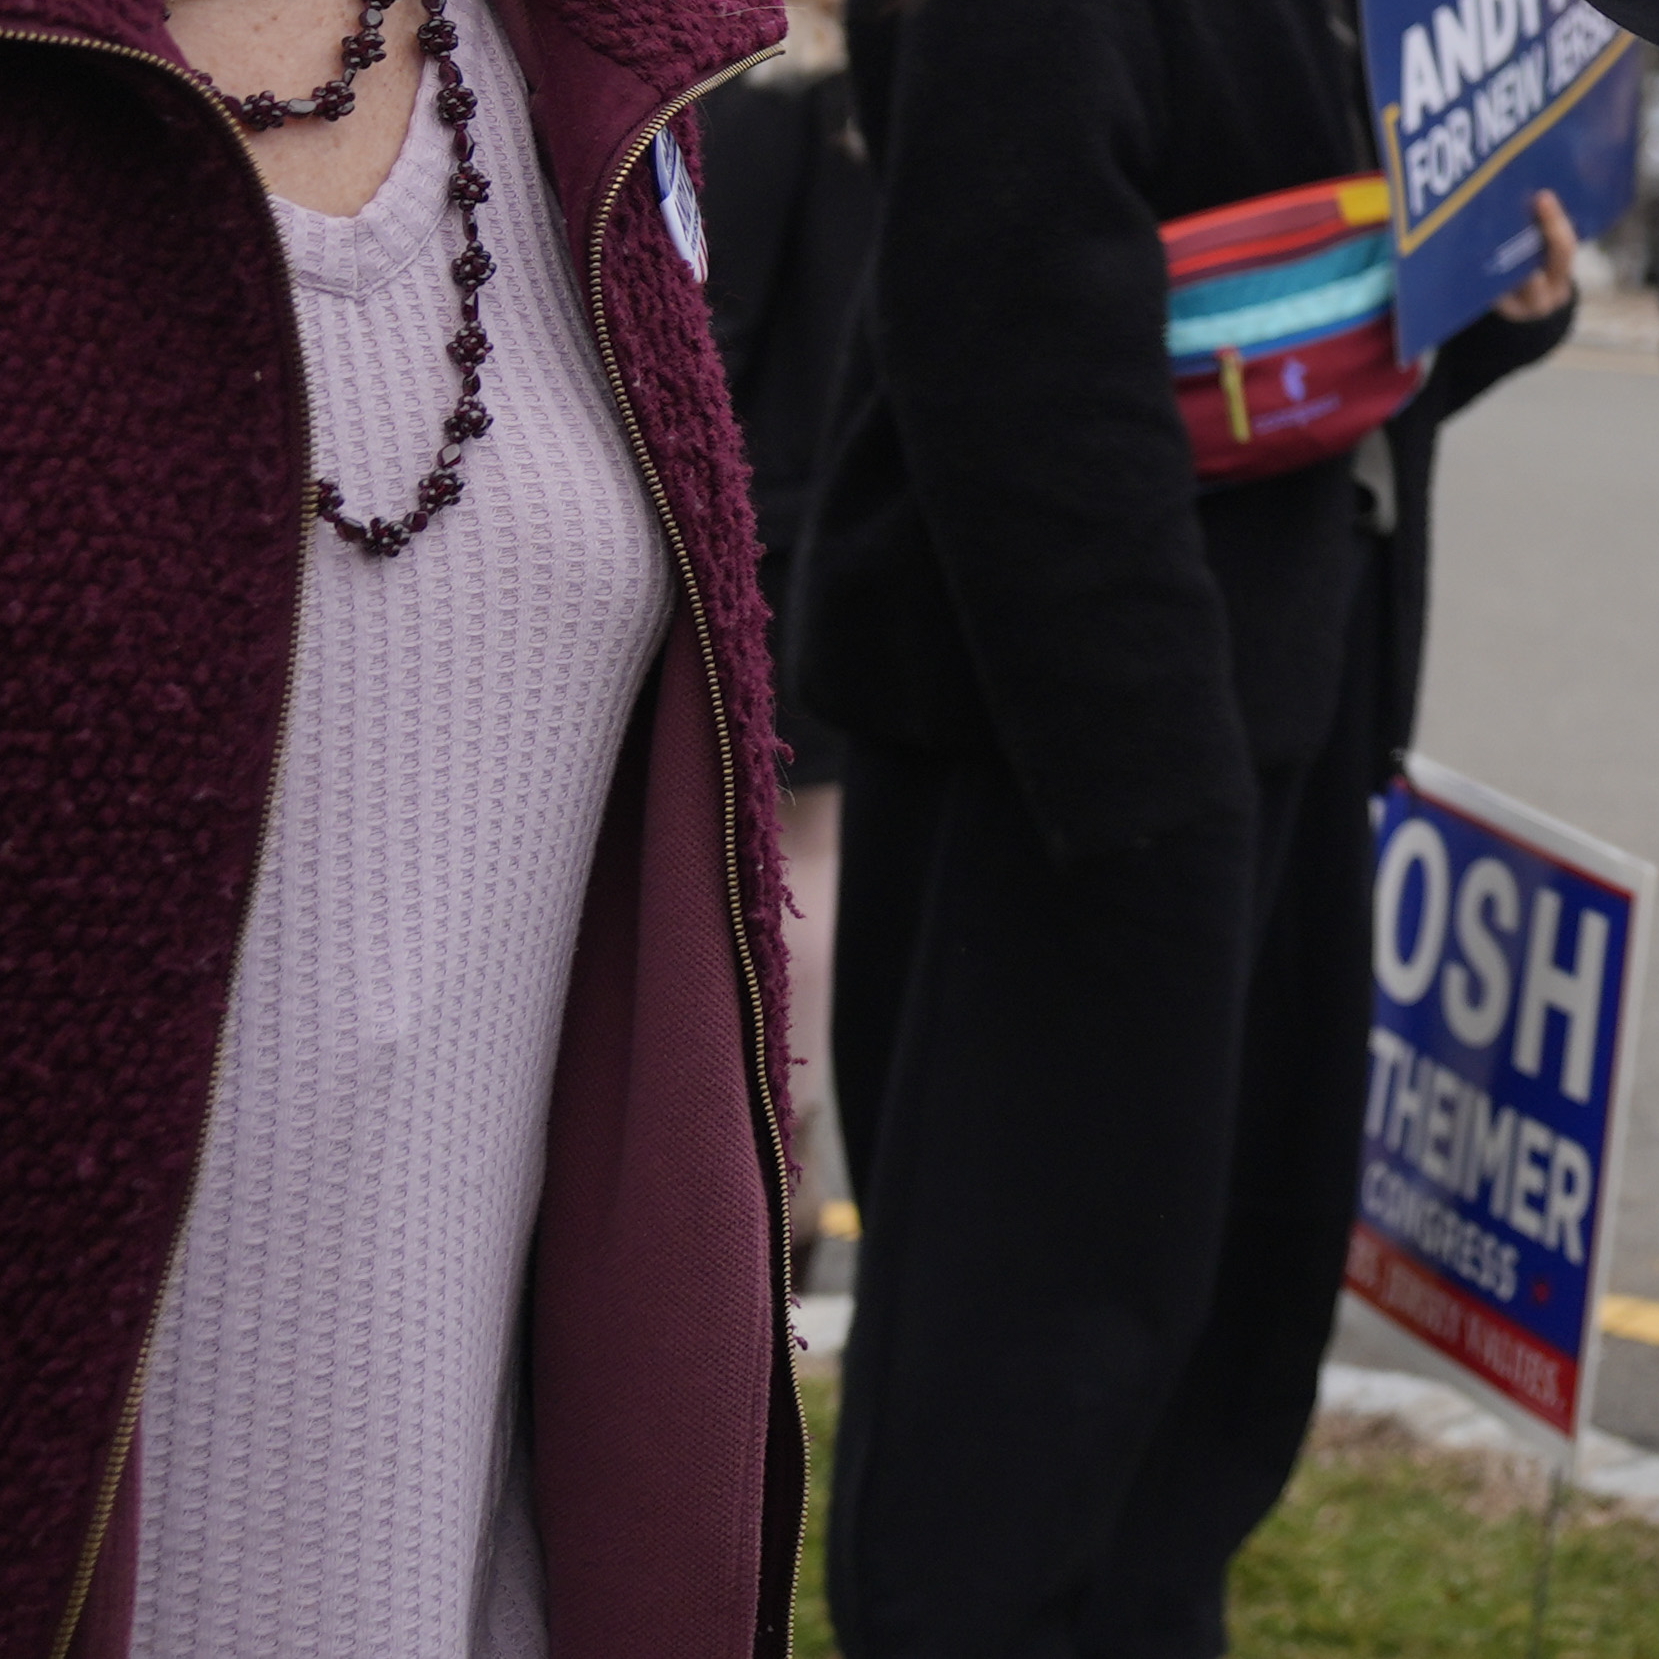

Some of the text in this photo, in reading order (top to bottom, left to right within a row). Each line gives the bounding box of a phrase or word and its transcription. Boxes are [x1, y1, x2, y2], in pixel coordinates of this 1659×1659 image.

[1405, 109, 1474, 216] FOR
[1474, 41, 1544, 156] NEW
[1370, 796, 1610, 1105] OSH
